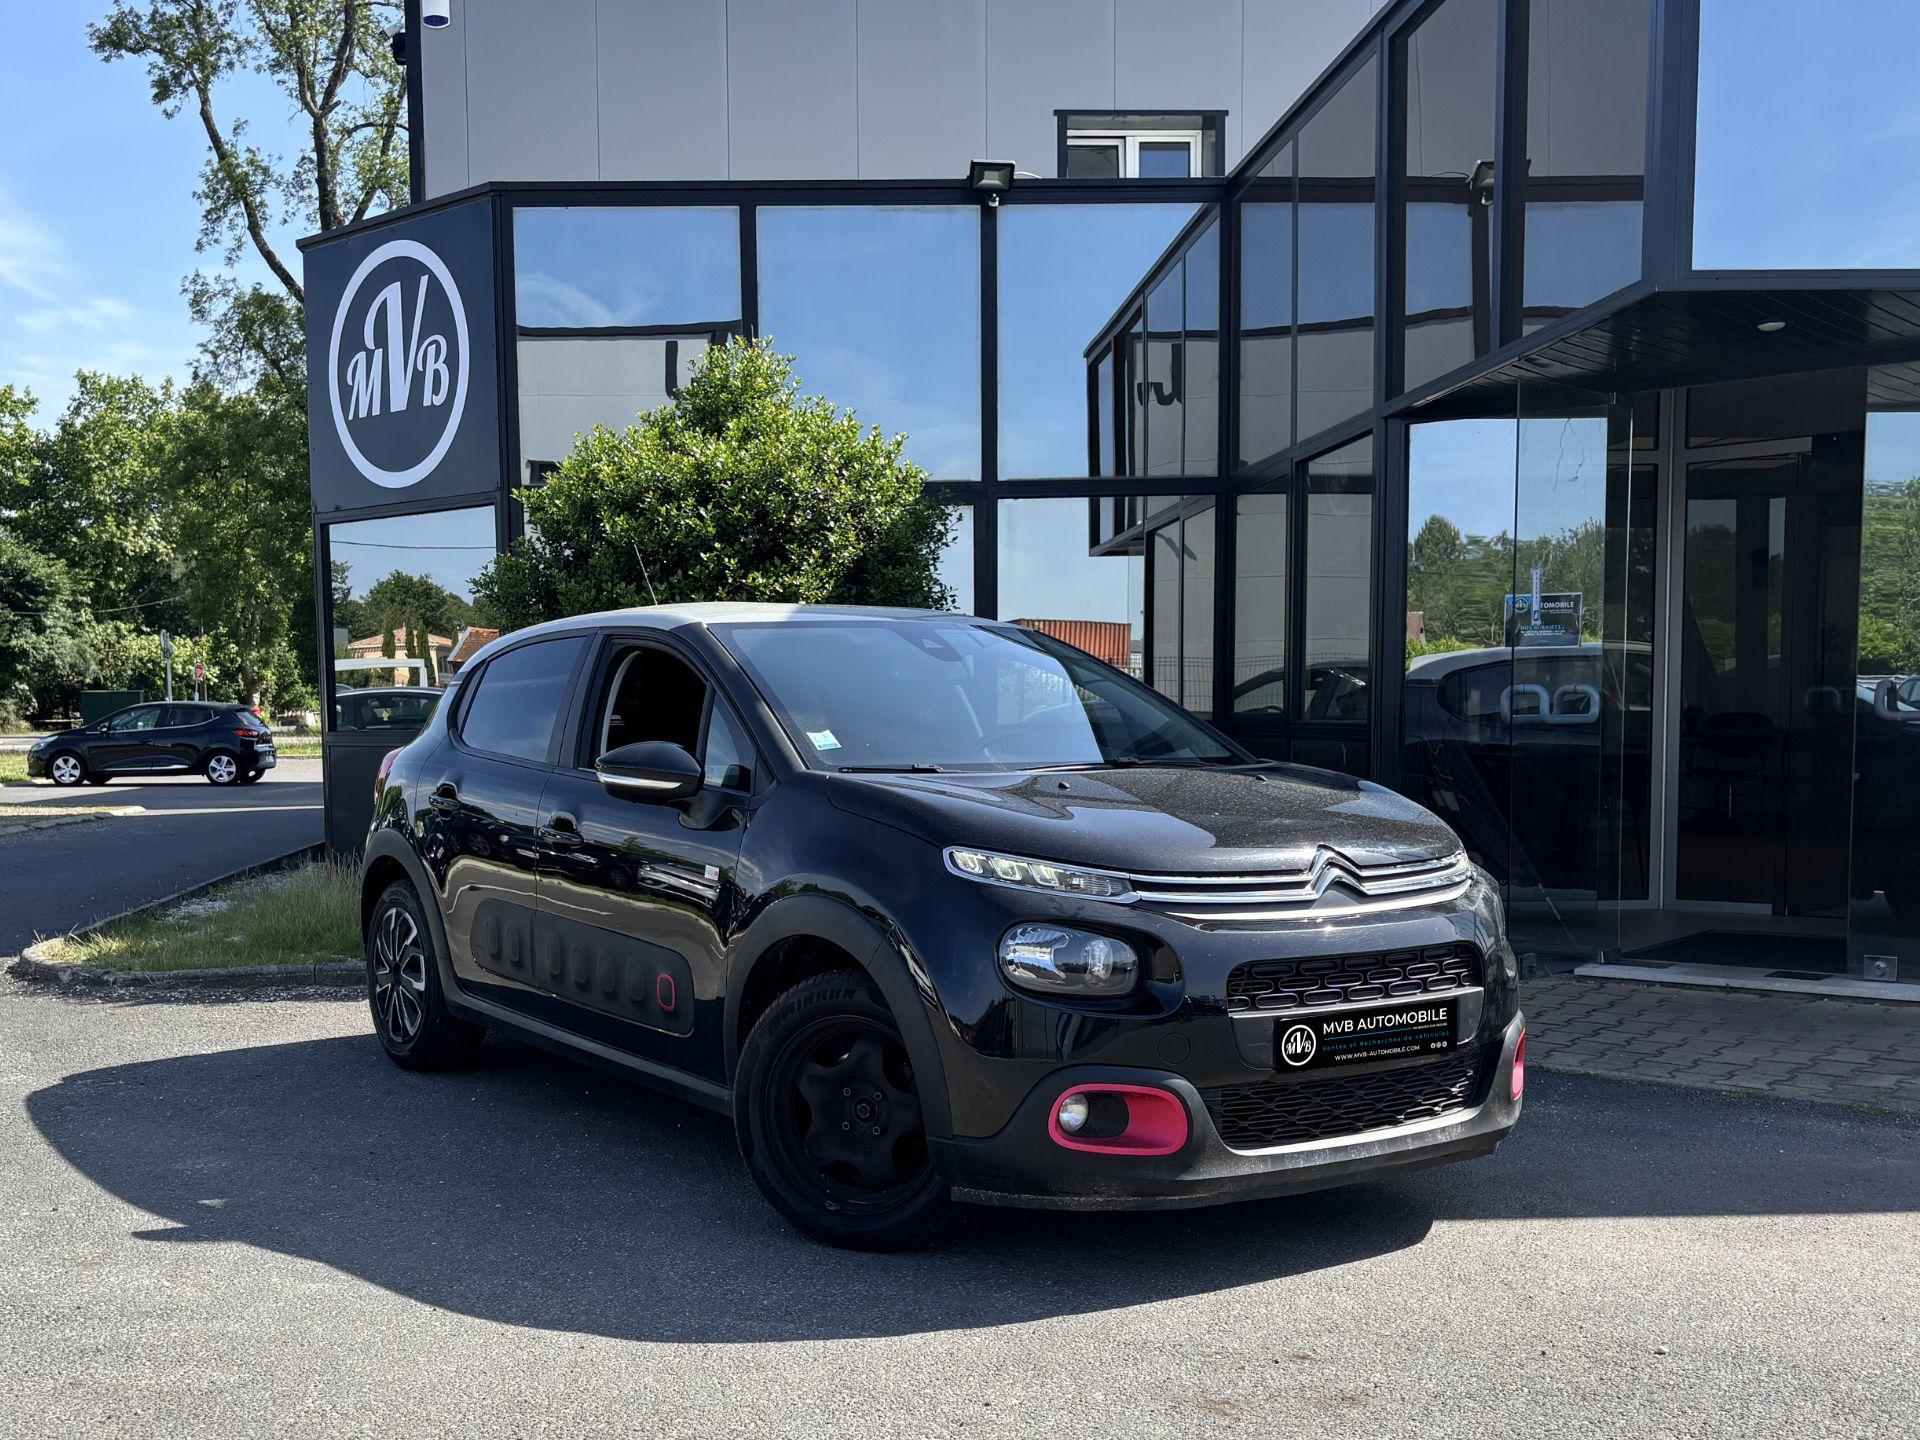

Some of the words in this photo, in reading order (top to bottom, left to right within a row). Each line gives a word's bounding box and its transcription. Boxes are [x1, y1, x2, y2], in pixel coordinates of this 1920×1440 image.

[346, 274, 450, 421] MVB
[1540, 601, 1575, 609] TOMOBILE
[1323, 1019, 1353, 1035] MVB
[1357, 1007, 1448, 1031] AUTOMOBILE
[1286, 1030, 1312, 1055] MVB
[1322, 1042, 1347, 1051] Ventes
[1359, 1036, 1401, 1046] Recherches
[1334, 1045, 1420, 1061] WWW.MVB-AUTOMOBILE.COM
